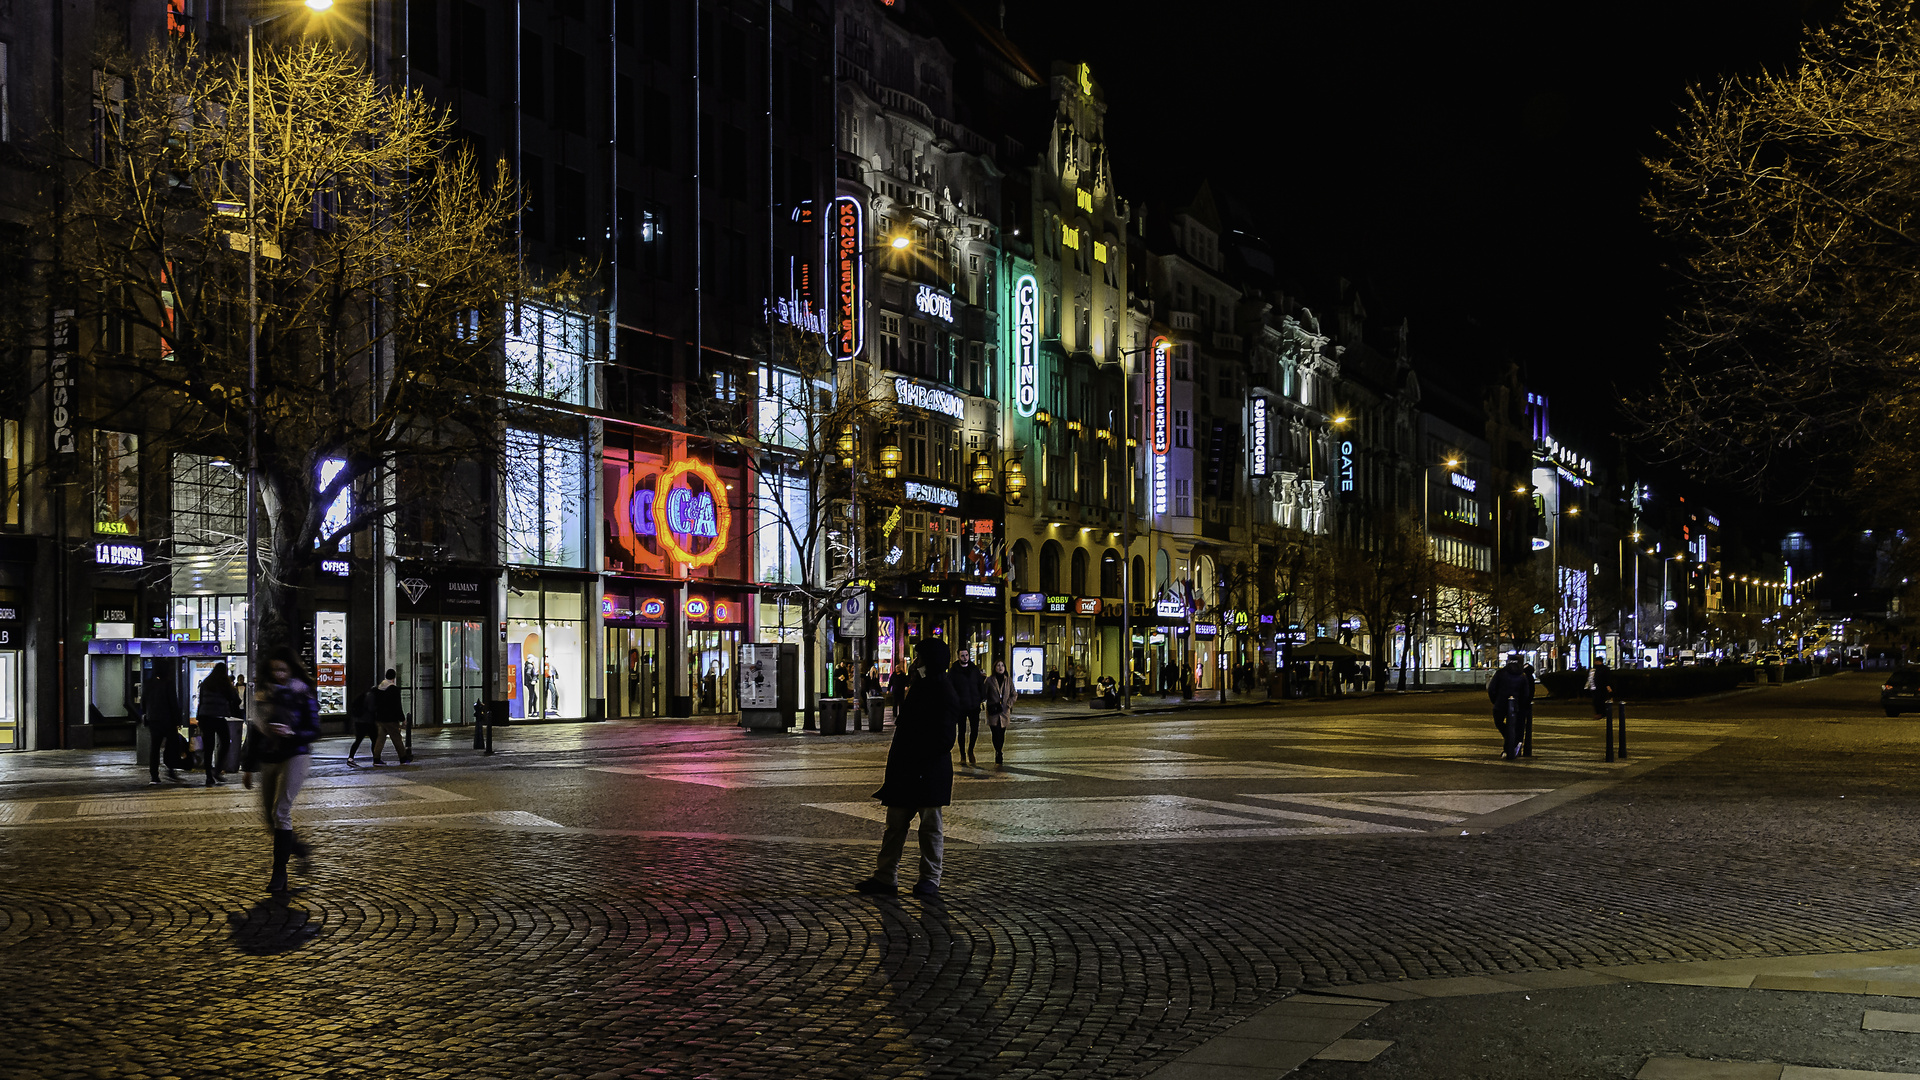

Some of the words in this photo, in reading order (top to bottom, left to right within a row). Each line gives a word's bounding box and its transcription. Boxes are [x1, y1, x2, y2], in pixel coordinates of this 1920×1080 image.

[916, 285, 954, 323] HOTEL
[1020, 286, 1035, 405] CASINO
[895, 378, 965, 420] AMBASSADOR
[1155, 406, 1165, 450] CENTRUM
[1341, 441, 1353, 491] GATE
[1156, 453, 1166, 513] RESERVE
[98, 521, 129, 534] PASTA
[667, 488, 719, 538] C&A
[96, 545, 110, 563] LA
[110, 546, 143, 566] BORSA
[322, 561, 349, 572] OFFICE
[449, 583, 478, 591] DIAMANT
[1047, 596, 1069, 604] LOBBY
[103, 610, 110, 620] LA
[111, 610, 127, 620] BORSA
[1101, 606, 1150, 618] HOEL
